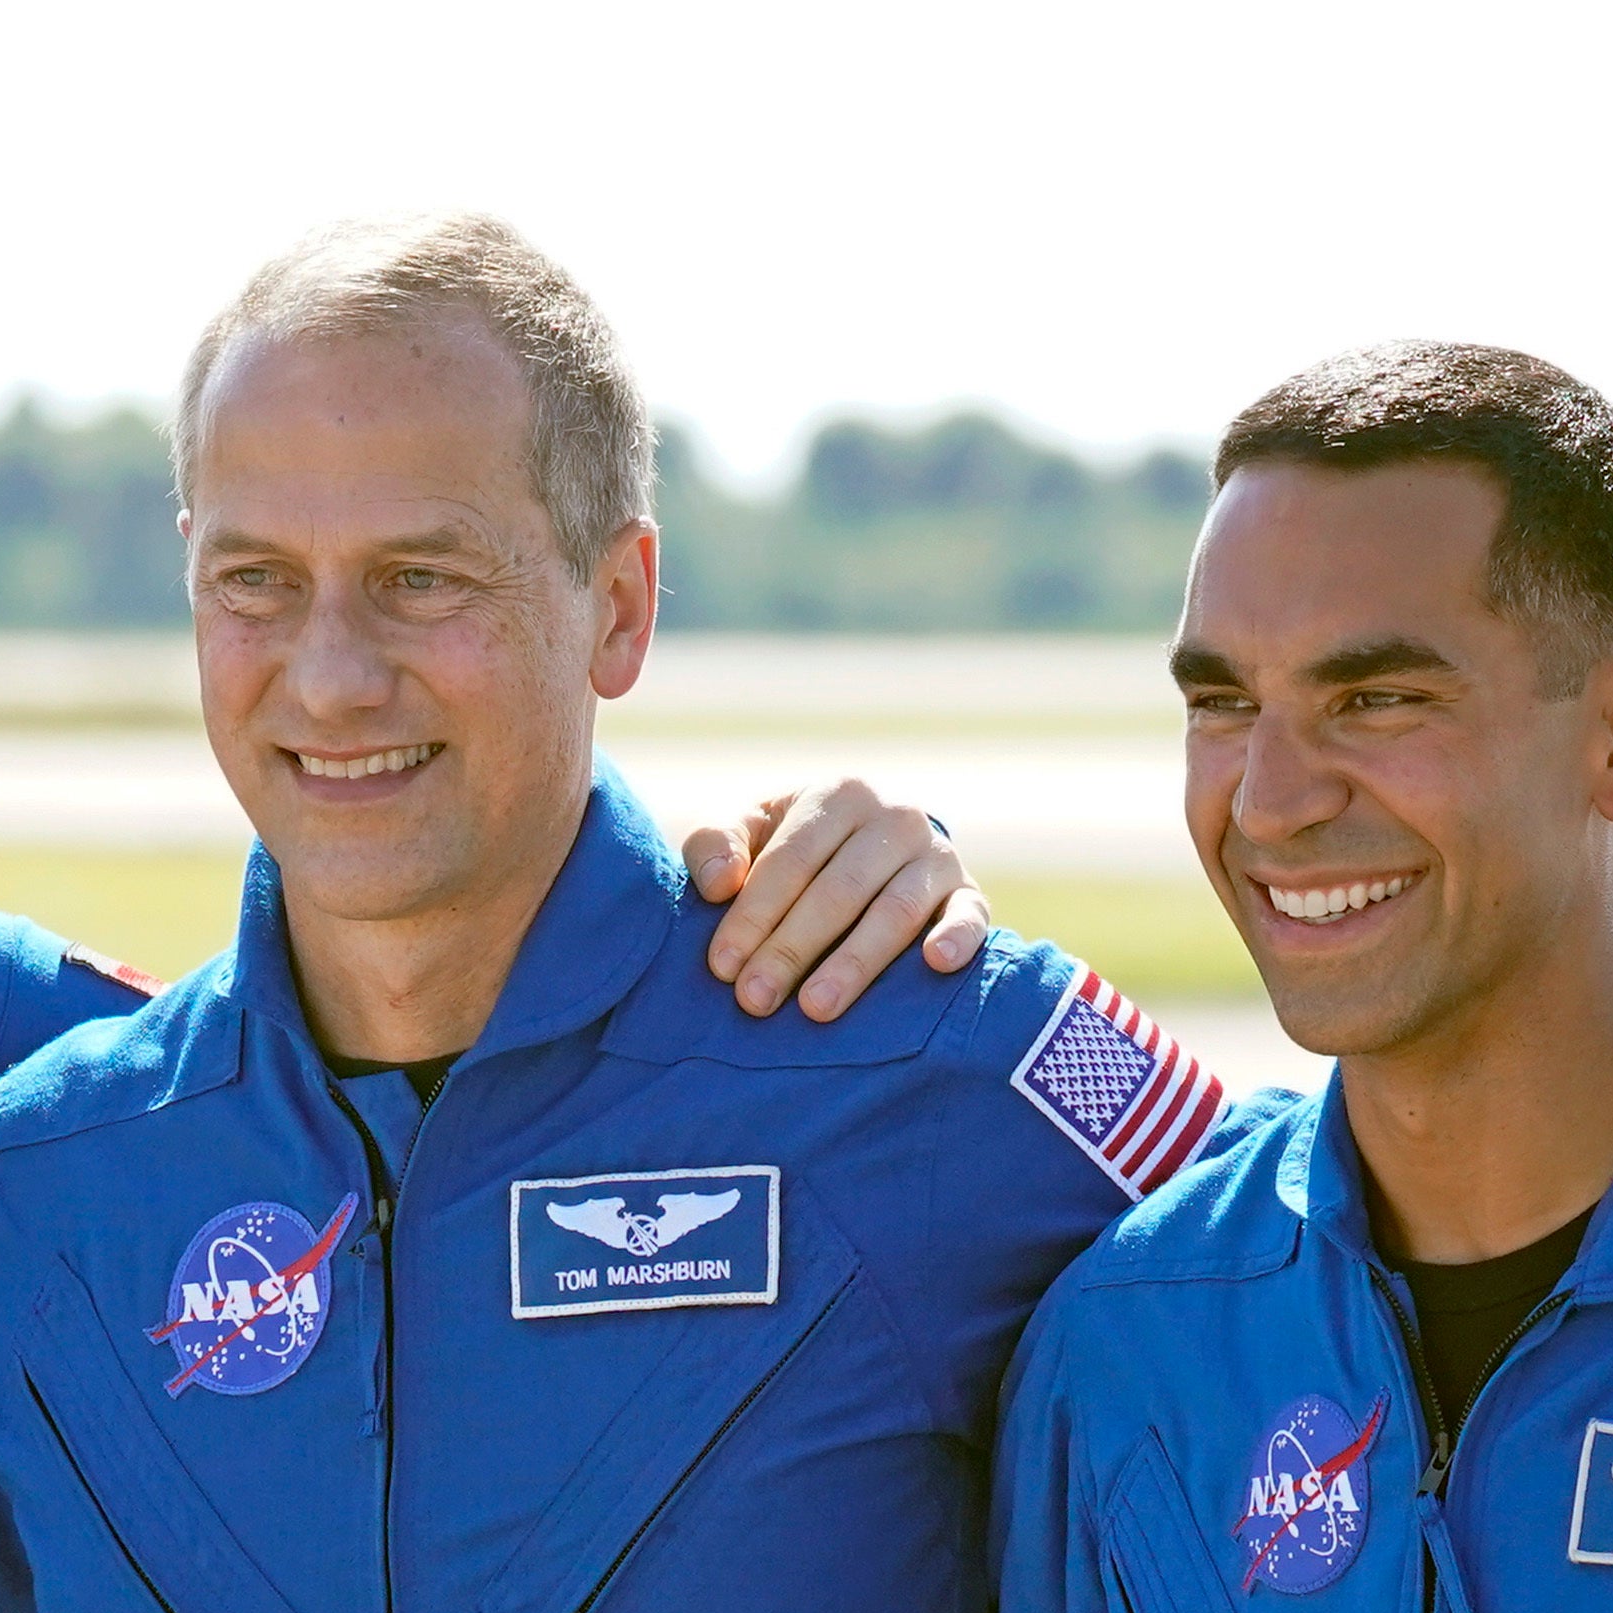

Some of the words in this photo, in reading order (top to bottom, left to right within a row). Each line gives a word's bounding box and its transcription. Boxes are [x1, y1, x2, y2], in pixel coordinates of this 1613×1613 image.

[183, 1273, 319, 1321] NASA
[555, 1269, 597, 1291] TOM
[607, 1259, 730, 1286] MARSHBURN
[1248, 1470, 1359, 1517] NASA
